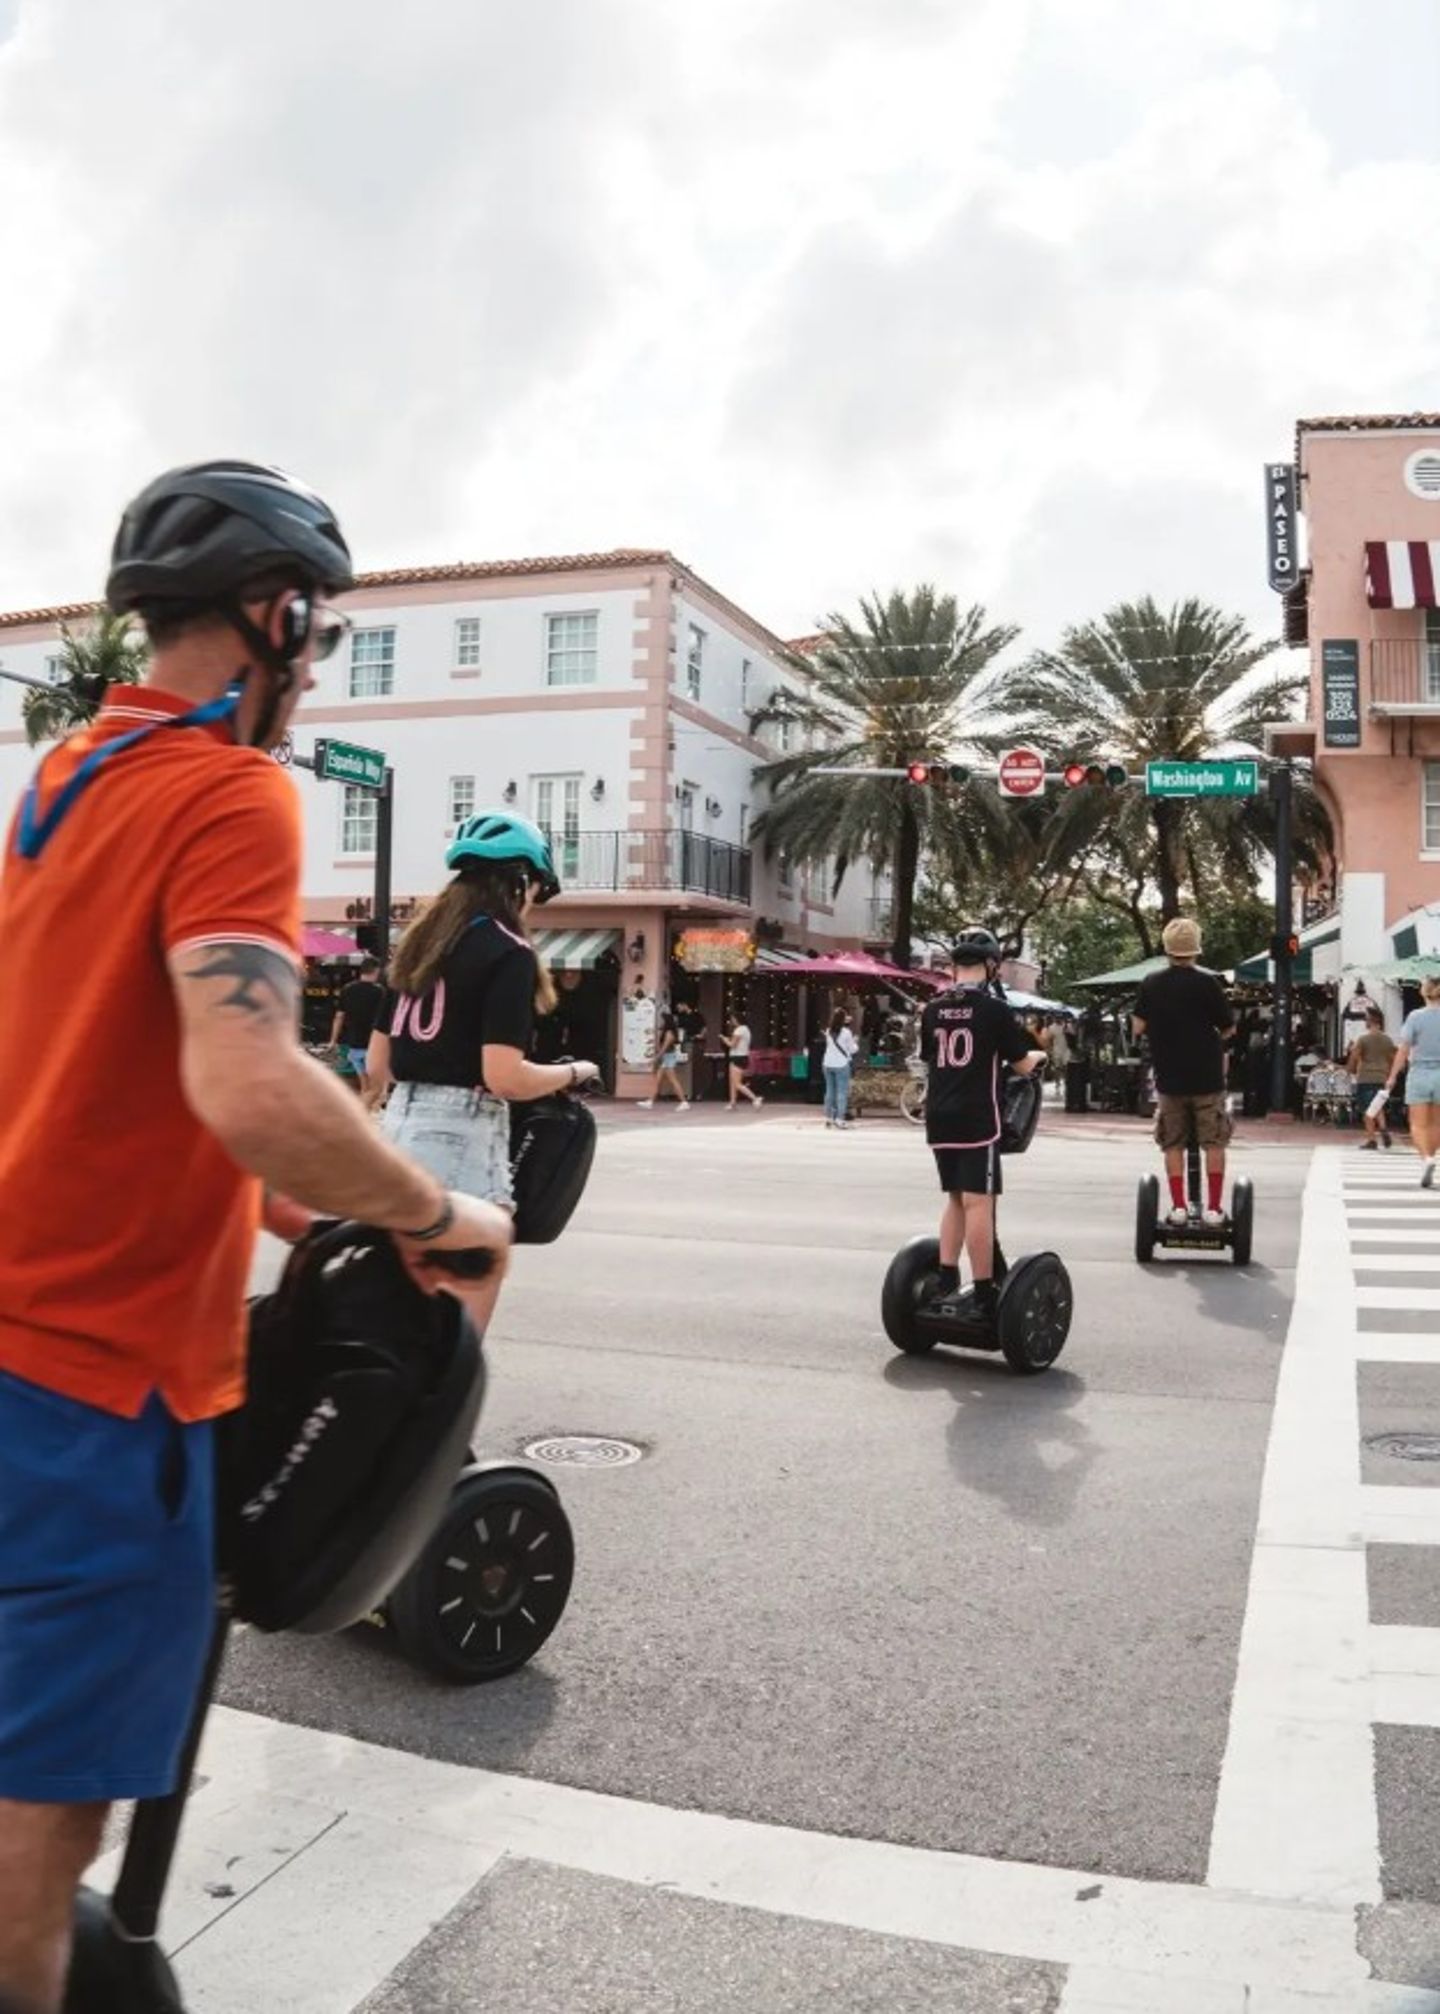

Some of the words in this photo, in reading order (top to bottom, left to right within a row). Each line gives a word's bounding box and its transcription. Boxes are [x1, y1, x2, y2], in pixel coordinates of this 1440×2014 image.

[1272, 467, 1286, 479] EL
[1274, 484, 1290, 573] PASEO
[1151, 770, 1224, 793] Washington
[1234, 769, 1252, 786] Av
[938, 1007, 973, 1019] MESSI
[934, 1027, 974, 1068] 10
